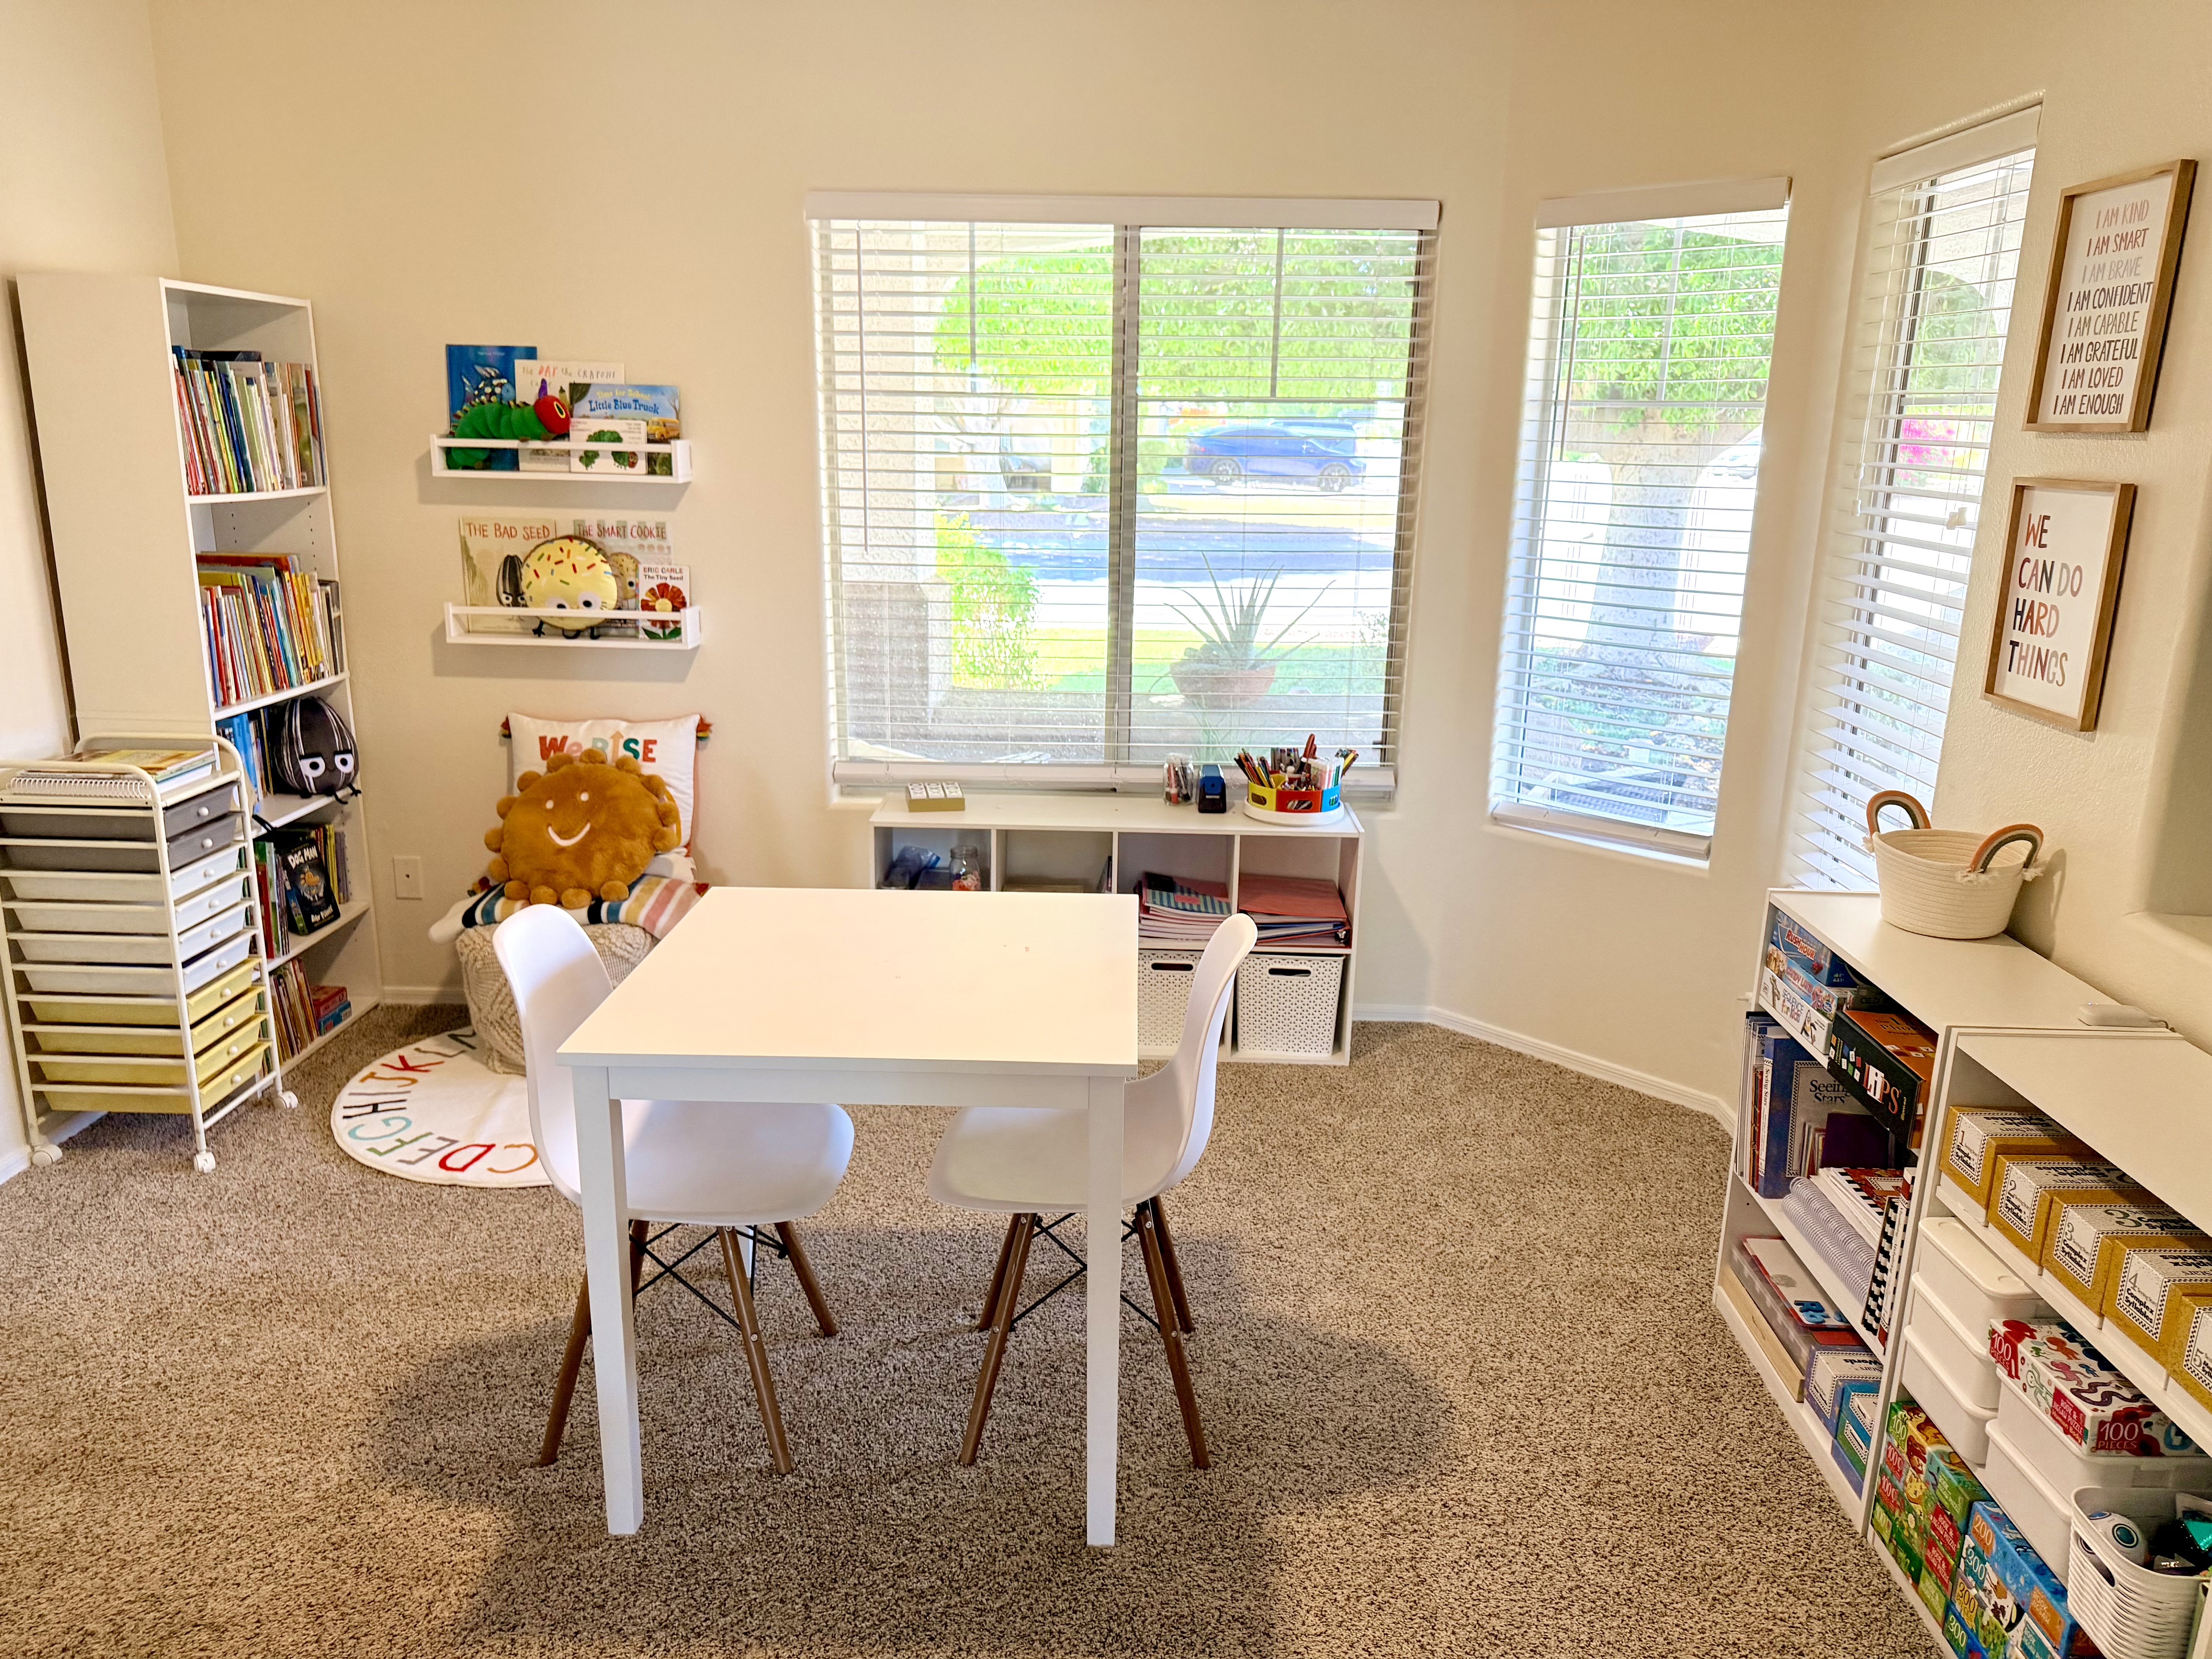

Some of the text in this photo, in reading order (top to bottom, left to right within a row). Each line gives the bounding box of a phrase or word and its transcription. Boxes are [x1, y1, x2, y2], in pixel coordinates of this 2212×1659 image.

[2096, 199, 2150, 229] I AM KIND
[2087, 228, 2149, 257] I AM SMART
[2082, 256, 2143, 284] I AM BRAVE
[2067, 281, 2154, 312] I AM CONFIDENT
[2068, 311, 2140, 337] I AM CAPABLE
[2060, 338, 2138, 364] I AM GRATEFUL
[539, 365, 558, 377] DAY
[2061, 366, 2123, 389] I AM LOVED
[597, 390, 613, 398] Time
[615, 388, 625, 397] for
[2053, 393, 2124, 415] I AM ENOUGH
[589, 398, 660, 414] Little Blue Truck
[466, 522, 550, 541] THE BAD SEED
[577, 522, 667, 539] THE SMART COOKIE
[2025, 513, 2051, 548] WE
[2018, 556, 2083, 597] CAN DO
[2013, 598, 2060, 638] HARD
[2008, 640, 2068, 687] THINGS
[288, 845, 318, 869] DOG MAN
[1786, 929, 1802, 947] RUSH
[1799, 942, 1815, 959] HOUR
[1782, 988, 1804, 1015] SEQUENCE
[1810, 1080, 1851, 1097] Seein
[2008, 1180, 2017, 1198] 2
[2004, 1203, 2027, 1226] Syllables
[2006, 1196, 2023, 1214] Simple
[2104, 1209, 2142, 1228] 3
[2065, 1222, 2075, 1241] 3
[2061, 1246, 2087, 1273] Syllables
[2063, 1239, 2088, 1265] Complex
[2128, 1272, 2138, 1292] 4
[2125, 1296, 2154, 1324] Syllables
[2126, 1288, 2154, 1315] Complex
[1990, 1346, 2010, 1370] PIECES
[1992, 1333, 2012, 1361] 100
[2193, 1348, 2204, 1367] 5
[2053, 1401, 2068, 1420] JIGSAW
[2068, 1415, 2083, 1436] PUZZLE
[2060, 1399, 2073, 1415] BOOK
[1893, 1415, 1907, 1440] 100
[2052, 1409, 2069, 1429] Human
[2069, 1425, 2082, 1443] Body
[2100, 1422, 2139, 1441] 100
[1887, 1445, 1898, 1466] 100
[2098, 1441, 2138, 1449] PIECES
[1882, 1475, 1892, 1497] 100
[1974, 1514, 1993, 1546] 200
[1966, 1548, 1986, 1580] 300
[1959, 1582, 1975, 1613] 300
[1949, 1615, 1966, 1647] 300
